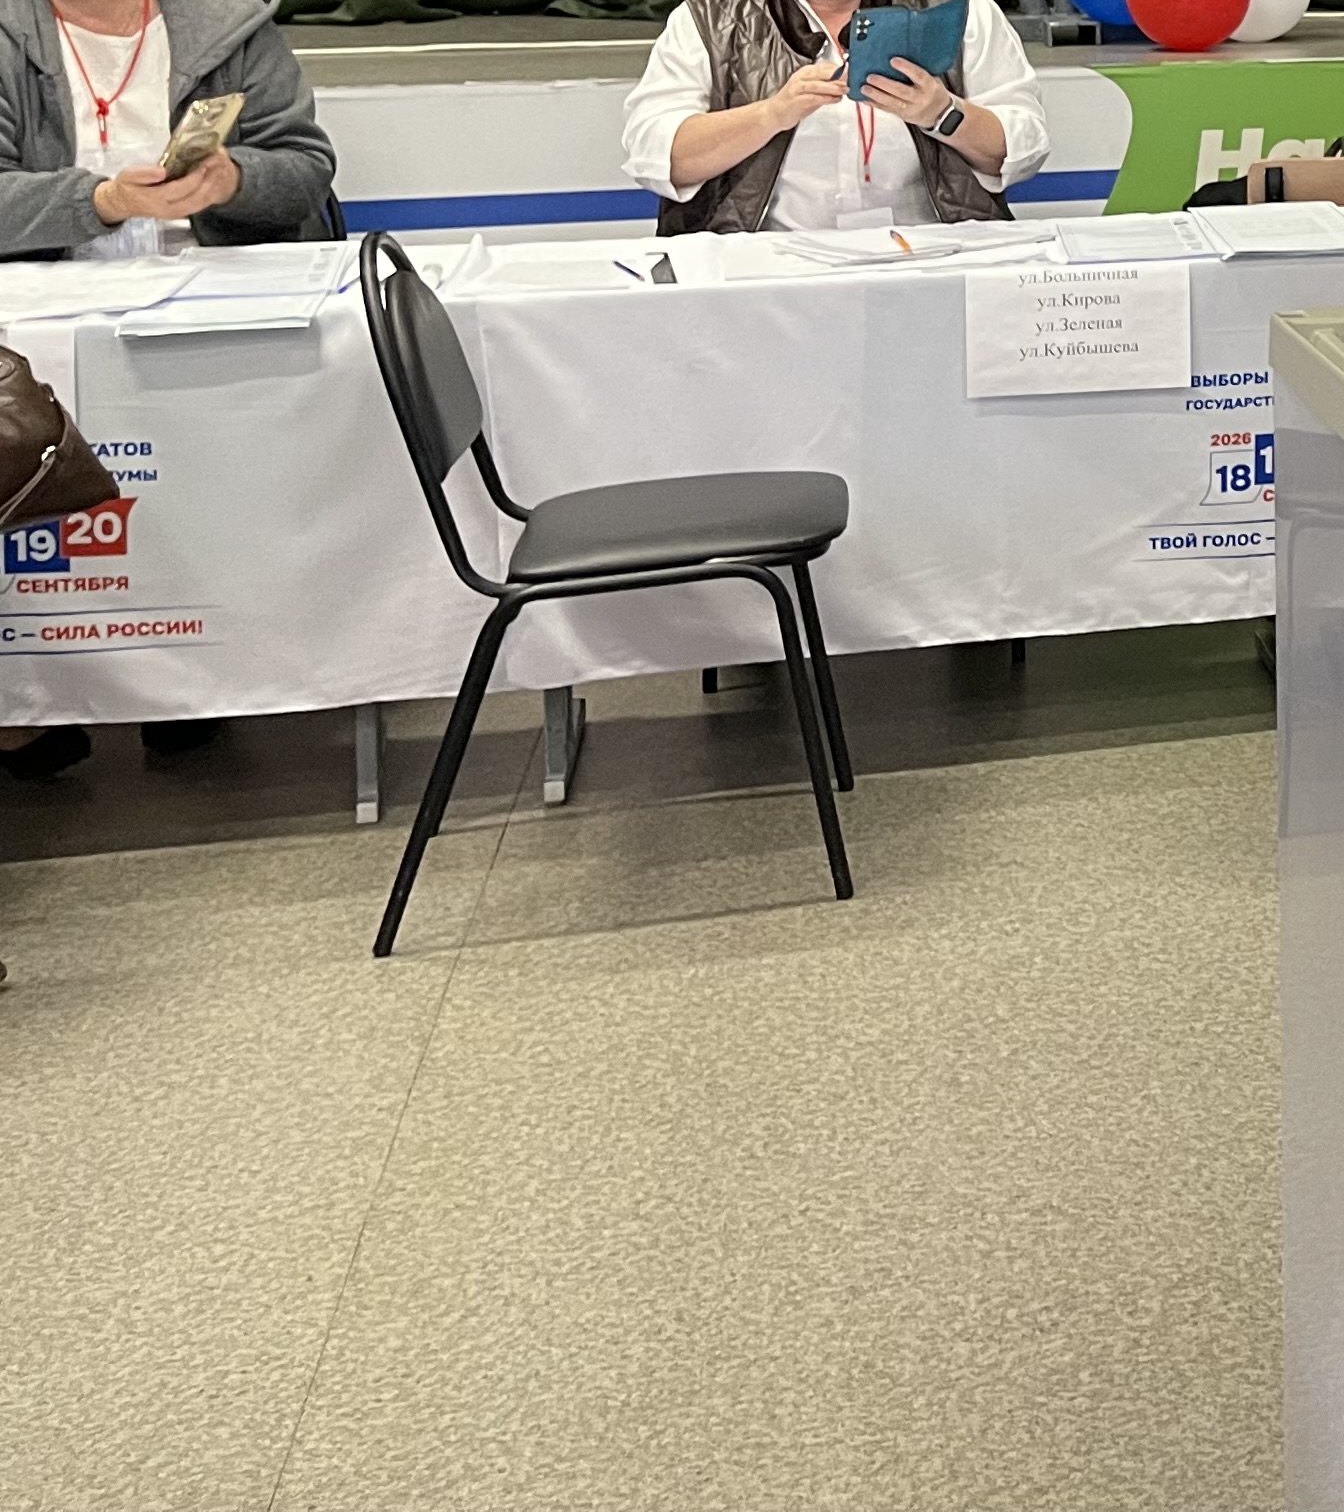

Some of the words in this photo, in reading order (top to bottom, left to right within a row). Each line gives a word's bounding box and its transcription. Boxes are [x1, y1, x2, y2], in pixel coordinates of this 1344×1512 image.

[1037, 292, 1121, 312] ул.Кирова
[1035, 317, 1122, 337] ул.Зеленая
[1019, 340, 1139, 362] ул.Куйбышева
[1190, 372, 1269, 388] ВЫБОРЫ
[1186, 395, 1274, 411] ГОСУДАРСТ
[1210, 432, 1252, 447] 2026
[1215, 464, 1251, 493] 18
[10, 529, 57, 562] 19
[66, 511, 123, 545] 20
[1149, 532, 1197, 550] ТВОЙ
[1202, 532, 1262, 548] ГОЛОС
[16, 576, 129, 594] СЕНТЯБРЯ
[41, 623, 100, 641] СИЛА
[106, 620, 203, 638] РОССИИ!
